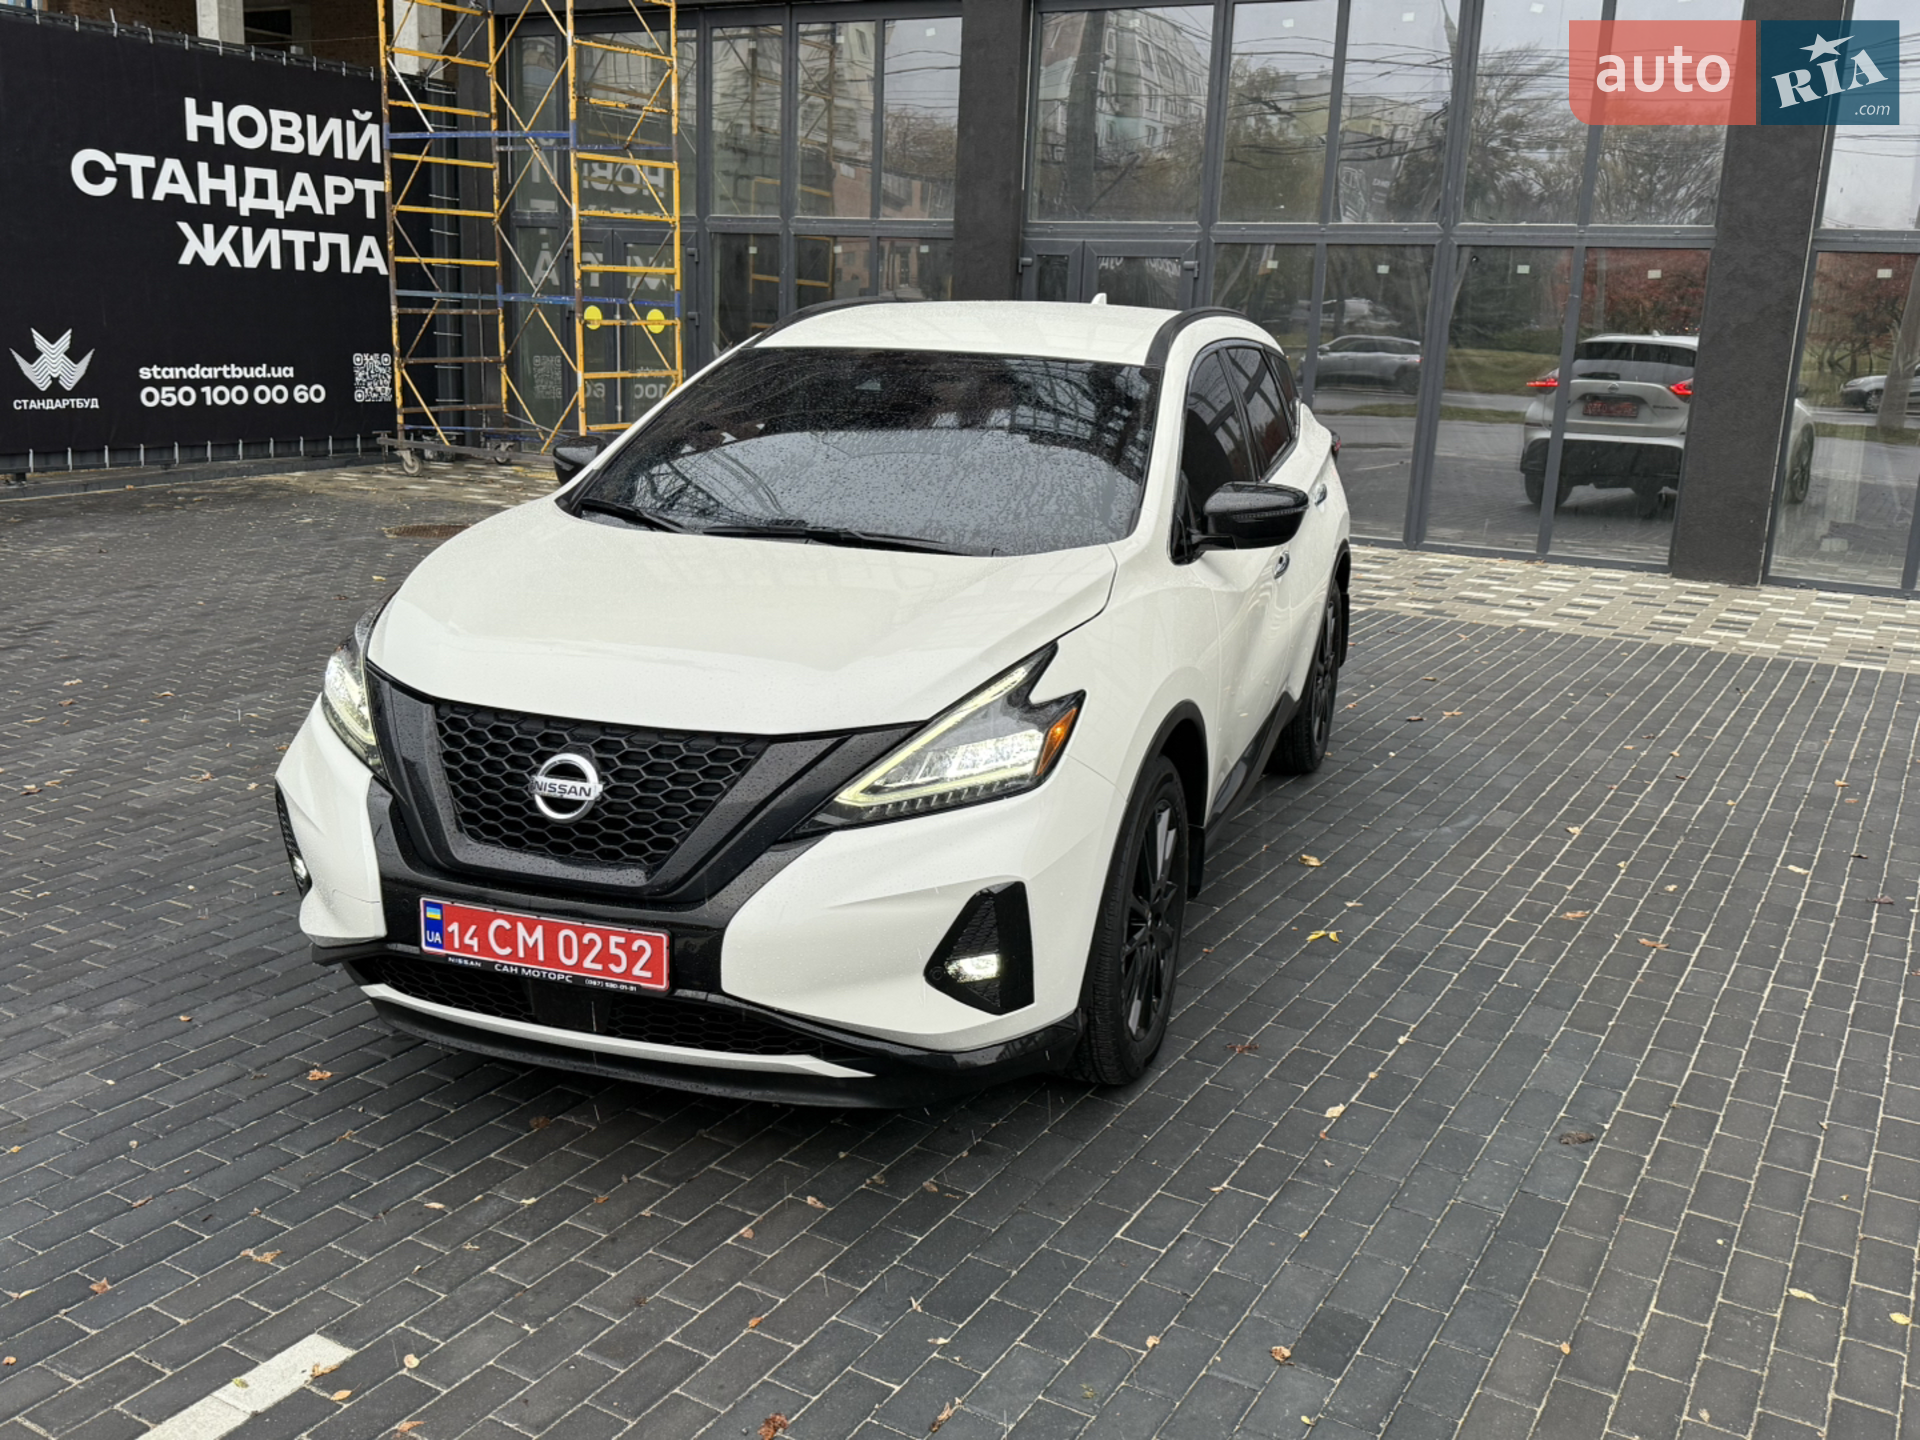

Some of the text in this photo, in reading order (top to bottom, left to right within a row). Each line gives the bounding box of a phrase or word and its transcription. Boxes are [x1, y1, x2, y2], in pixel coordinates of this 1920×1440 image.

[184, 97, 382, 164] НОВИЙ
[70, 148, 385, 220] СТАНДАРТ
[176, 220, 389, 275] ЖИТЛА
[139, 363, 294, 380] standartbud.ua
[13, 397, 99, 410] СТАНДАРТБУД
[140, 383, 326, 408] 050 100 00 60
[535, 780, 592, 797] NISSAN
[426, 930, 442, 944] UA
[447, 921, 479, 952] 14
[557, 928, 653, 978] 0252
[448, 957, 482, 967] NISSAN
[494, 963, 573, 983] САН МОТОРС
